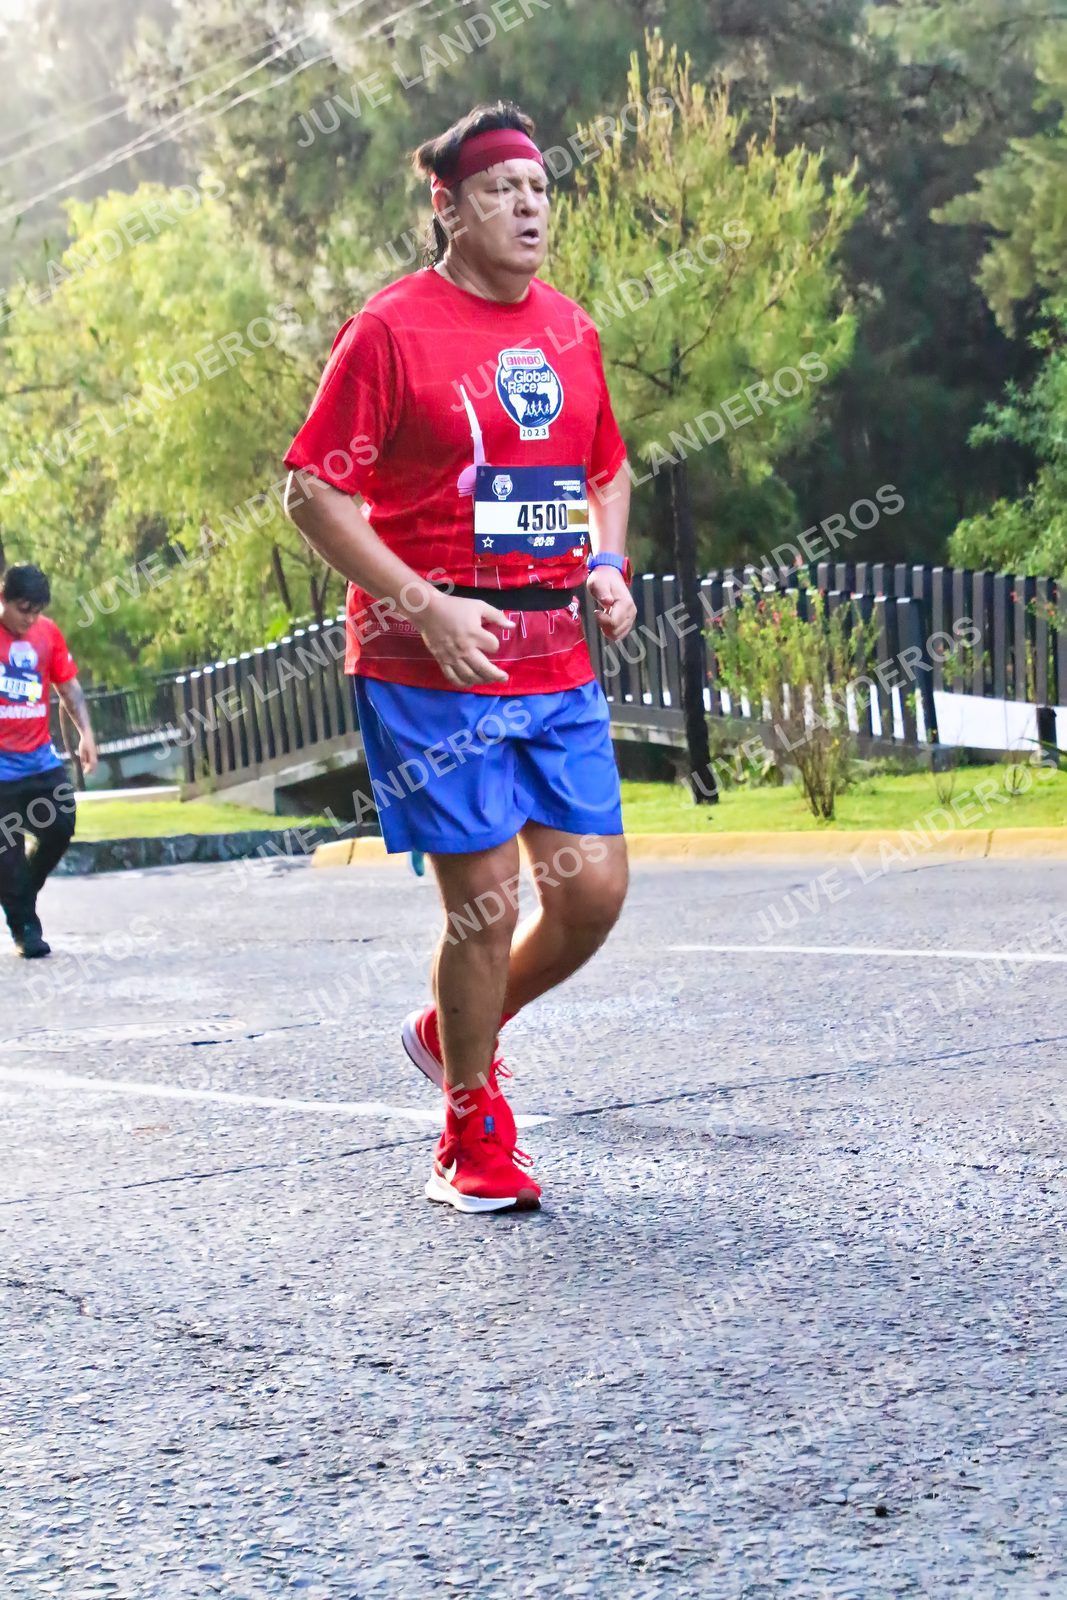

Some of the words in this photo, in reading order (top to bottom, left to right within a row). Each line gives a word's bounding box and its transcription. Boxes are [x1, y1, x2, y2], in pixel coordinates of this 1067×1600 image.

[506, 356, 541, 366] BIMBO
[514, 370, 551, 383] Global
[507, 381, 537, 394] Race
[522, 428, 547, 437] 2023
[517, 503, 568, 532] 4500
[533, 536, 555, 547] 20-26
